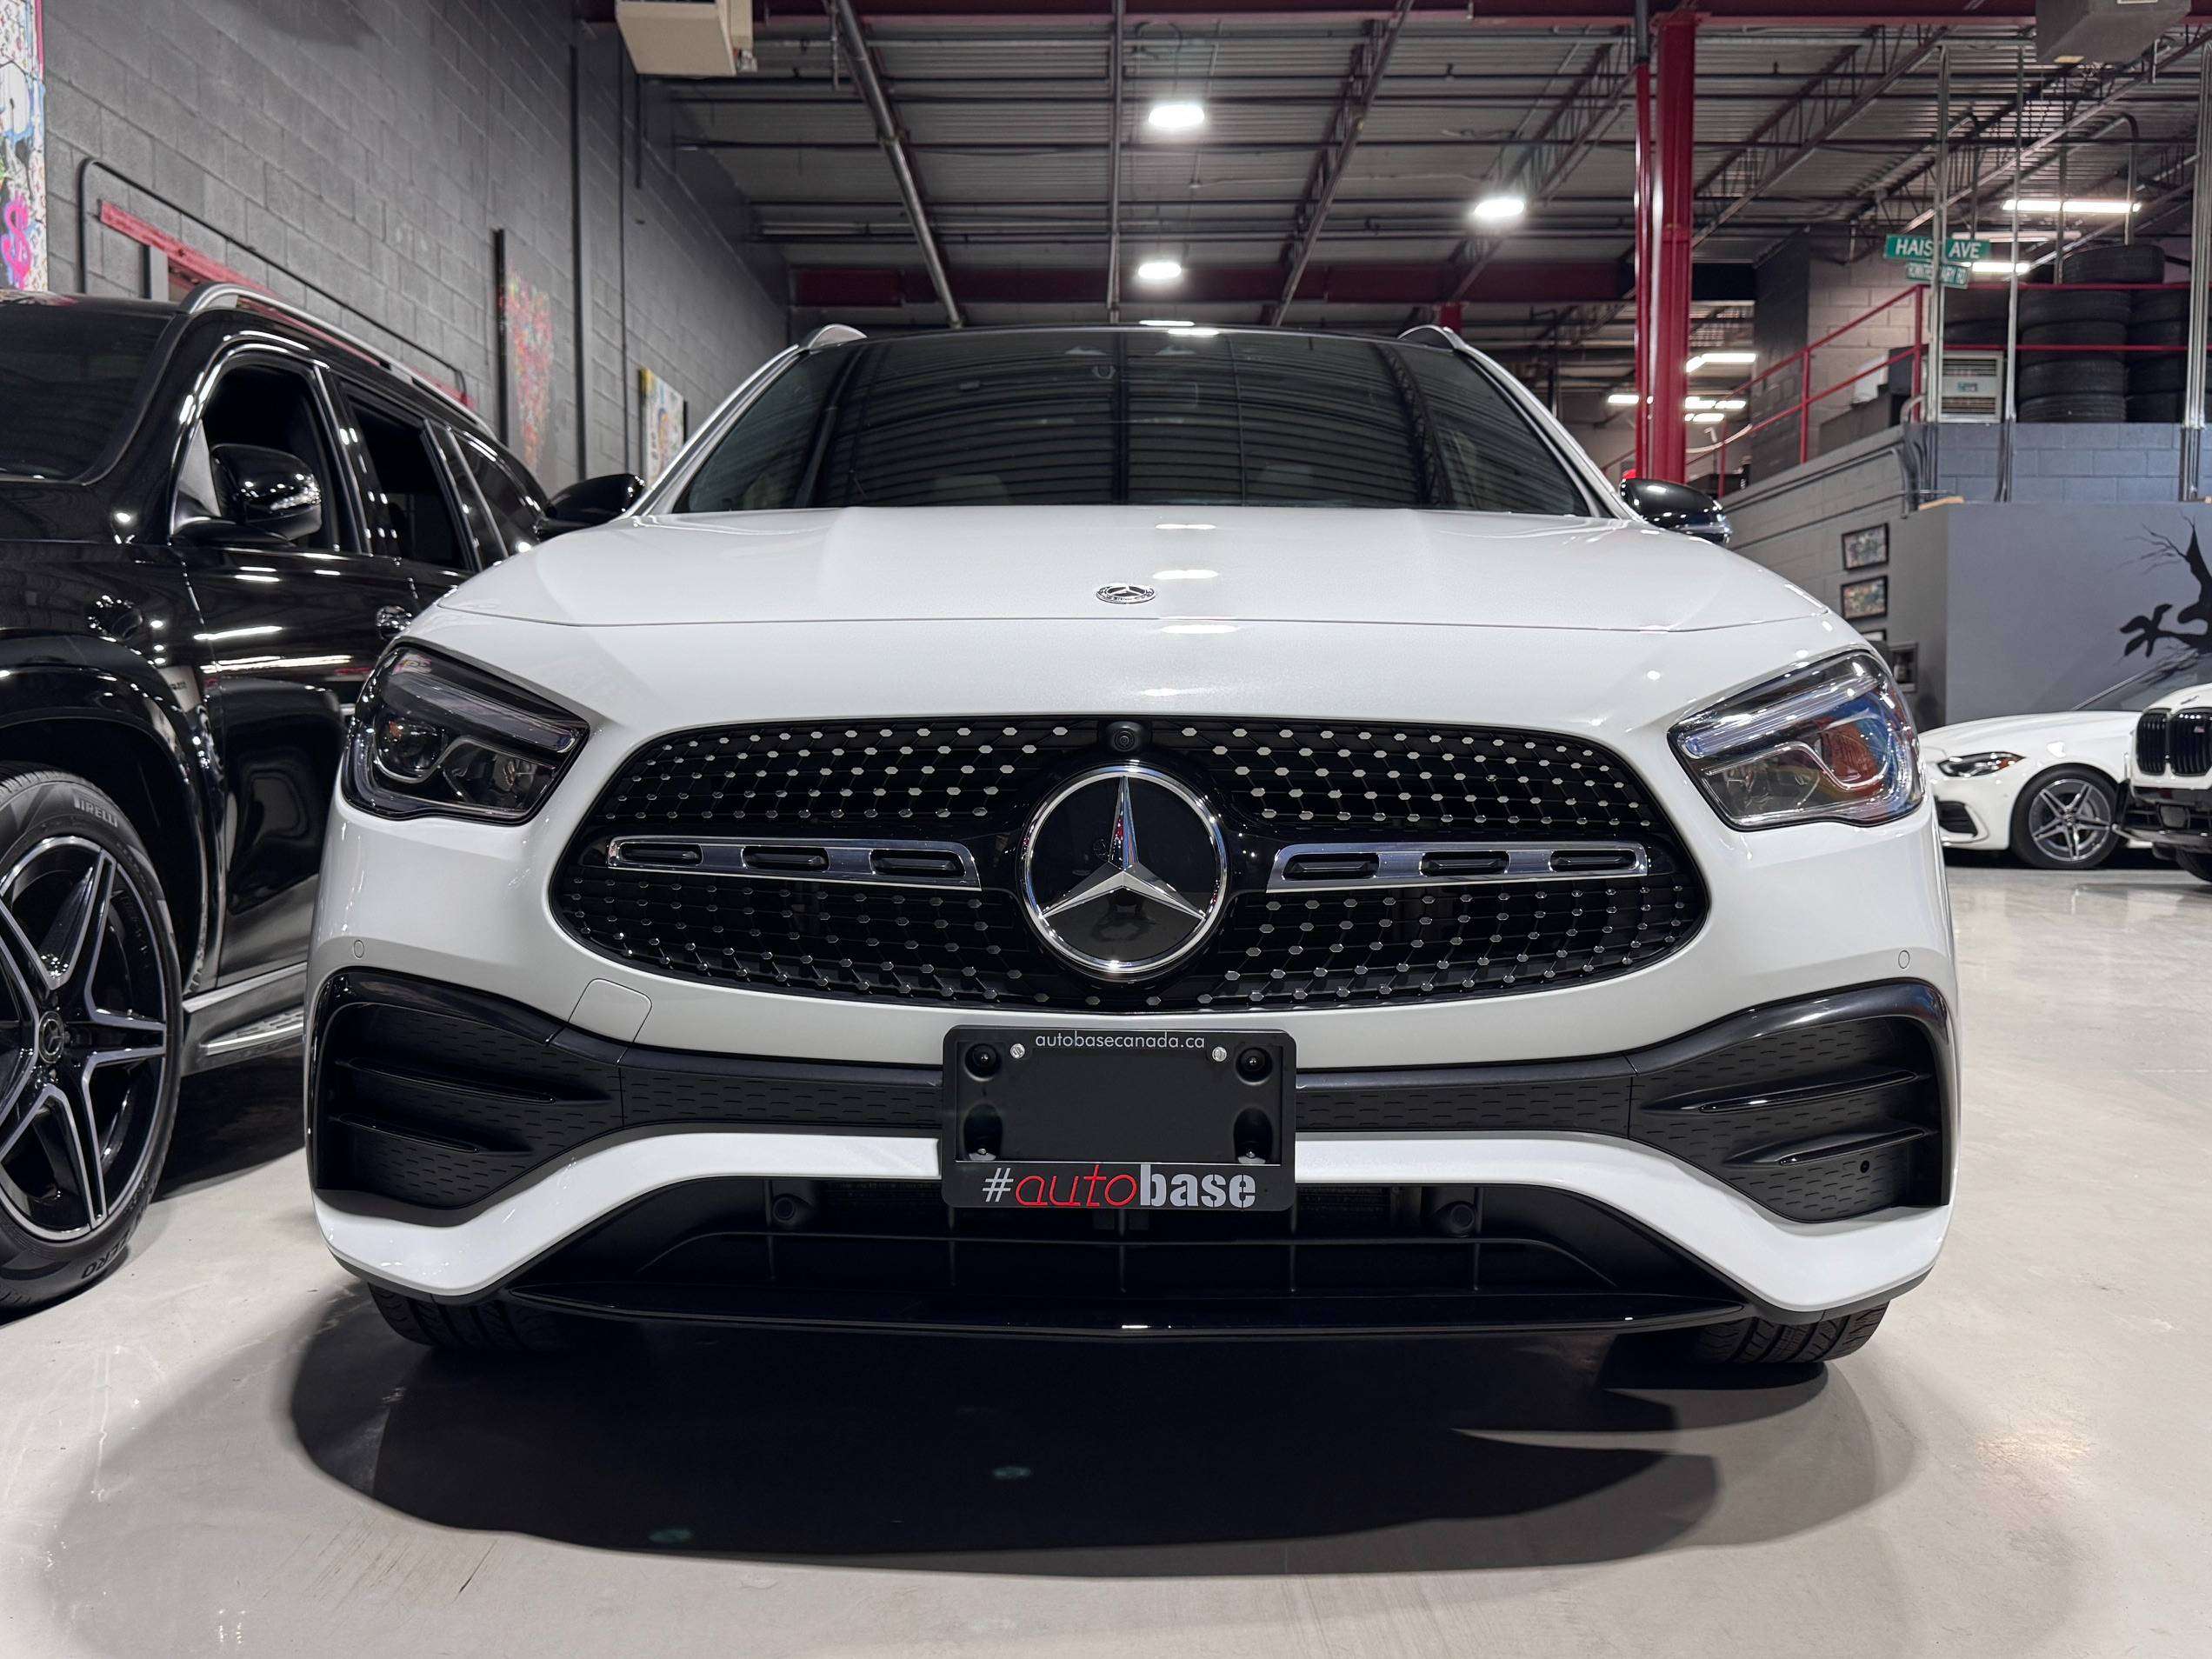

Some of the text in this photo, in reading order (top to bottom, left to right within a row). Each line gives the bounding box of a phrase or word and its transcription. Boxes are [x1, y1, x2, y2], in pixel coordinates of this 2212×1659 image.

[1896, 237, 1982, 259] HAIS AVE
[1035, 1029, 1205, 1049] autobasecanada.ca
[982, 1163, 1256, 1209] #autobase
